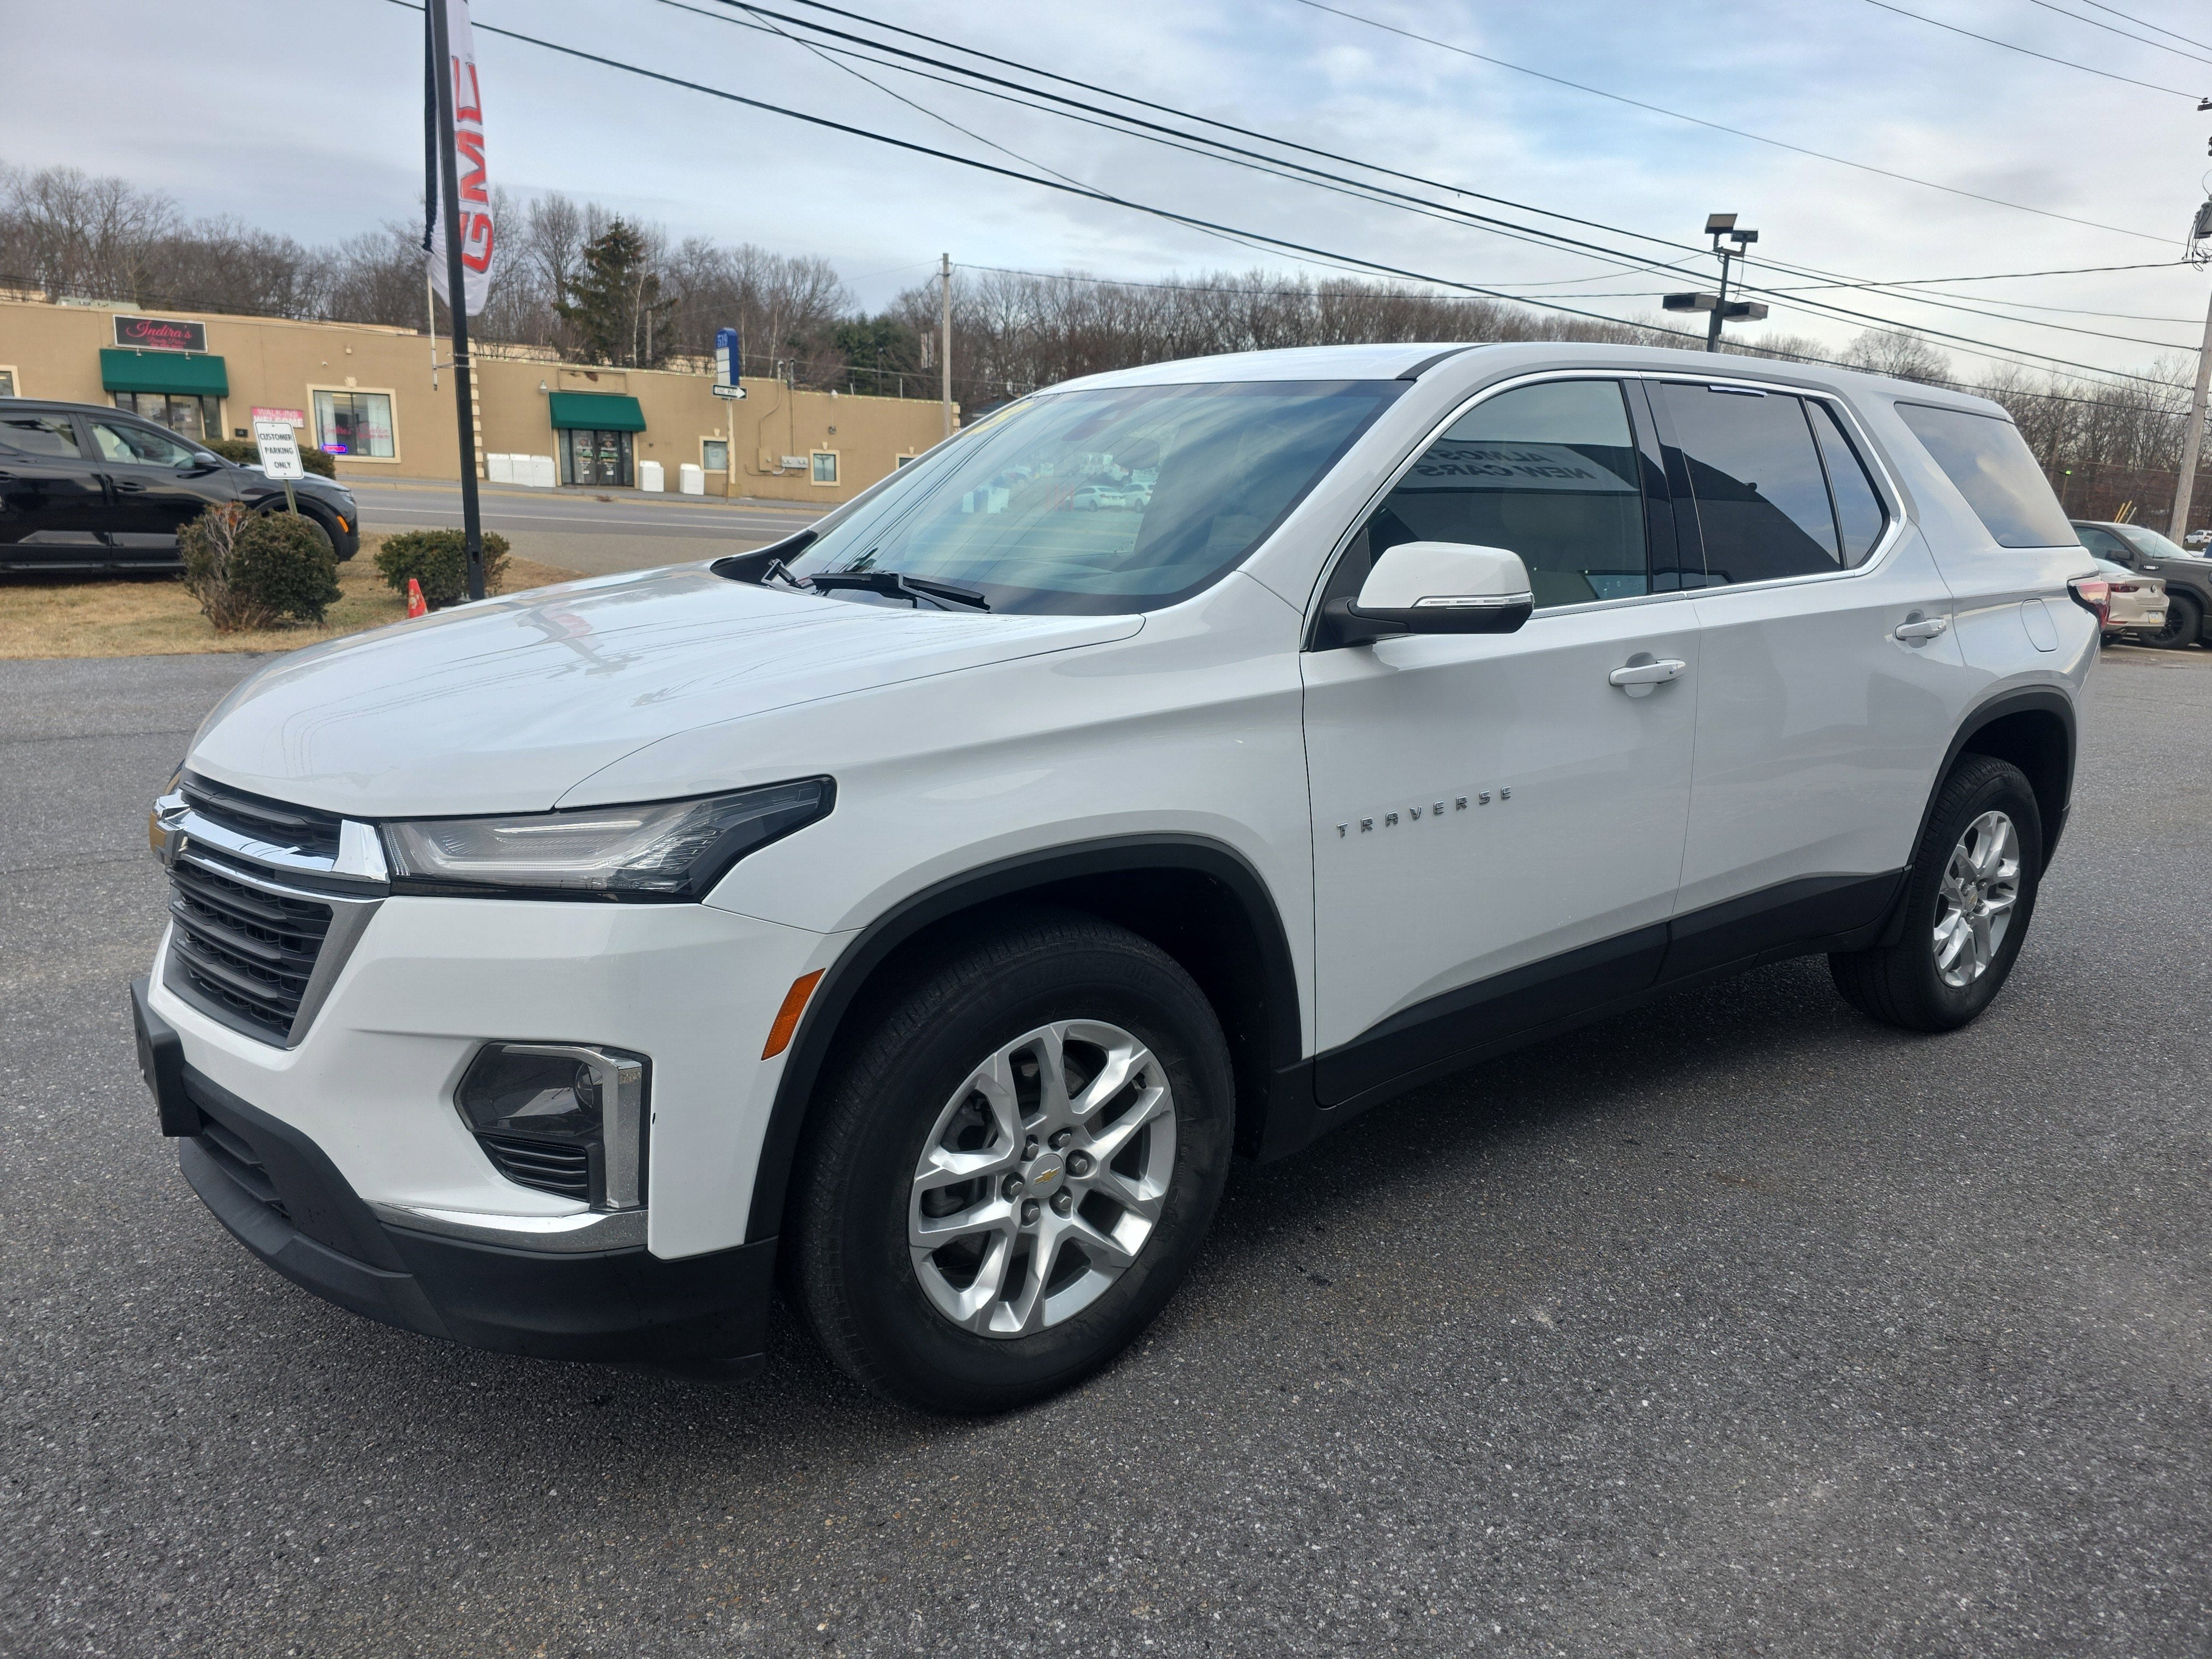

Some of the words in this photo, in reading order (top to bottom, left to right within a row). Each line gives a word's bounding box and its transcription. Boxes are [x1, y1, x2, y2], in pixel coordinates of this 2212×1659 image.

[452, 55, 494, 274] GMC
[126, 320, 192, 339] Indira's
[717, 333, 728, 348] 519
[260, 433, 293, 441] CUSTOMER
[264, 447, 294, 455] PARKING
[1336, 785, 1512, 838] TRAVERSE
